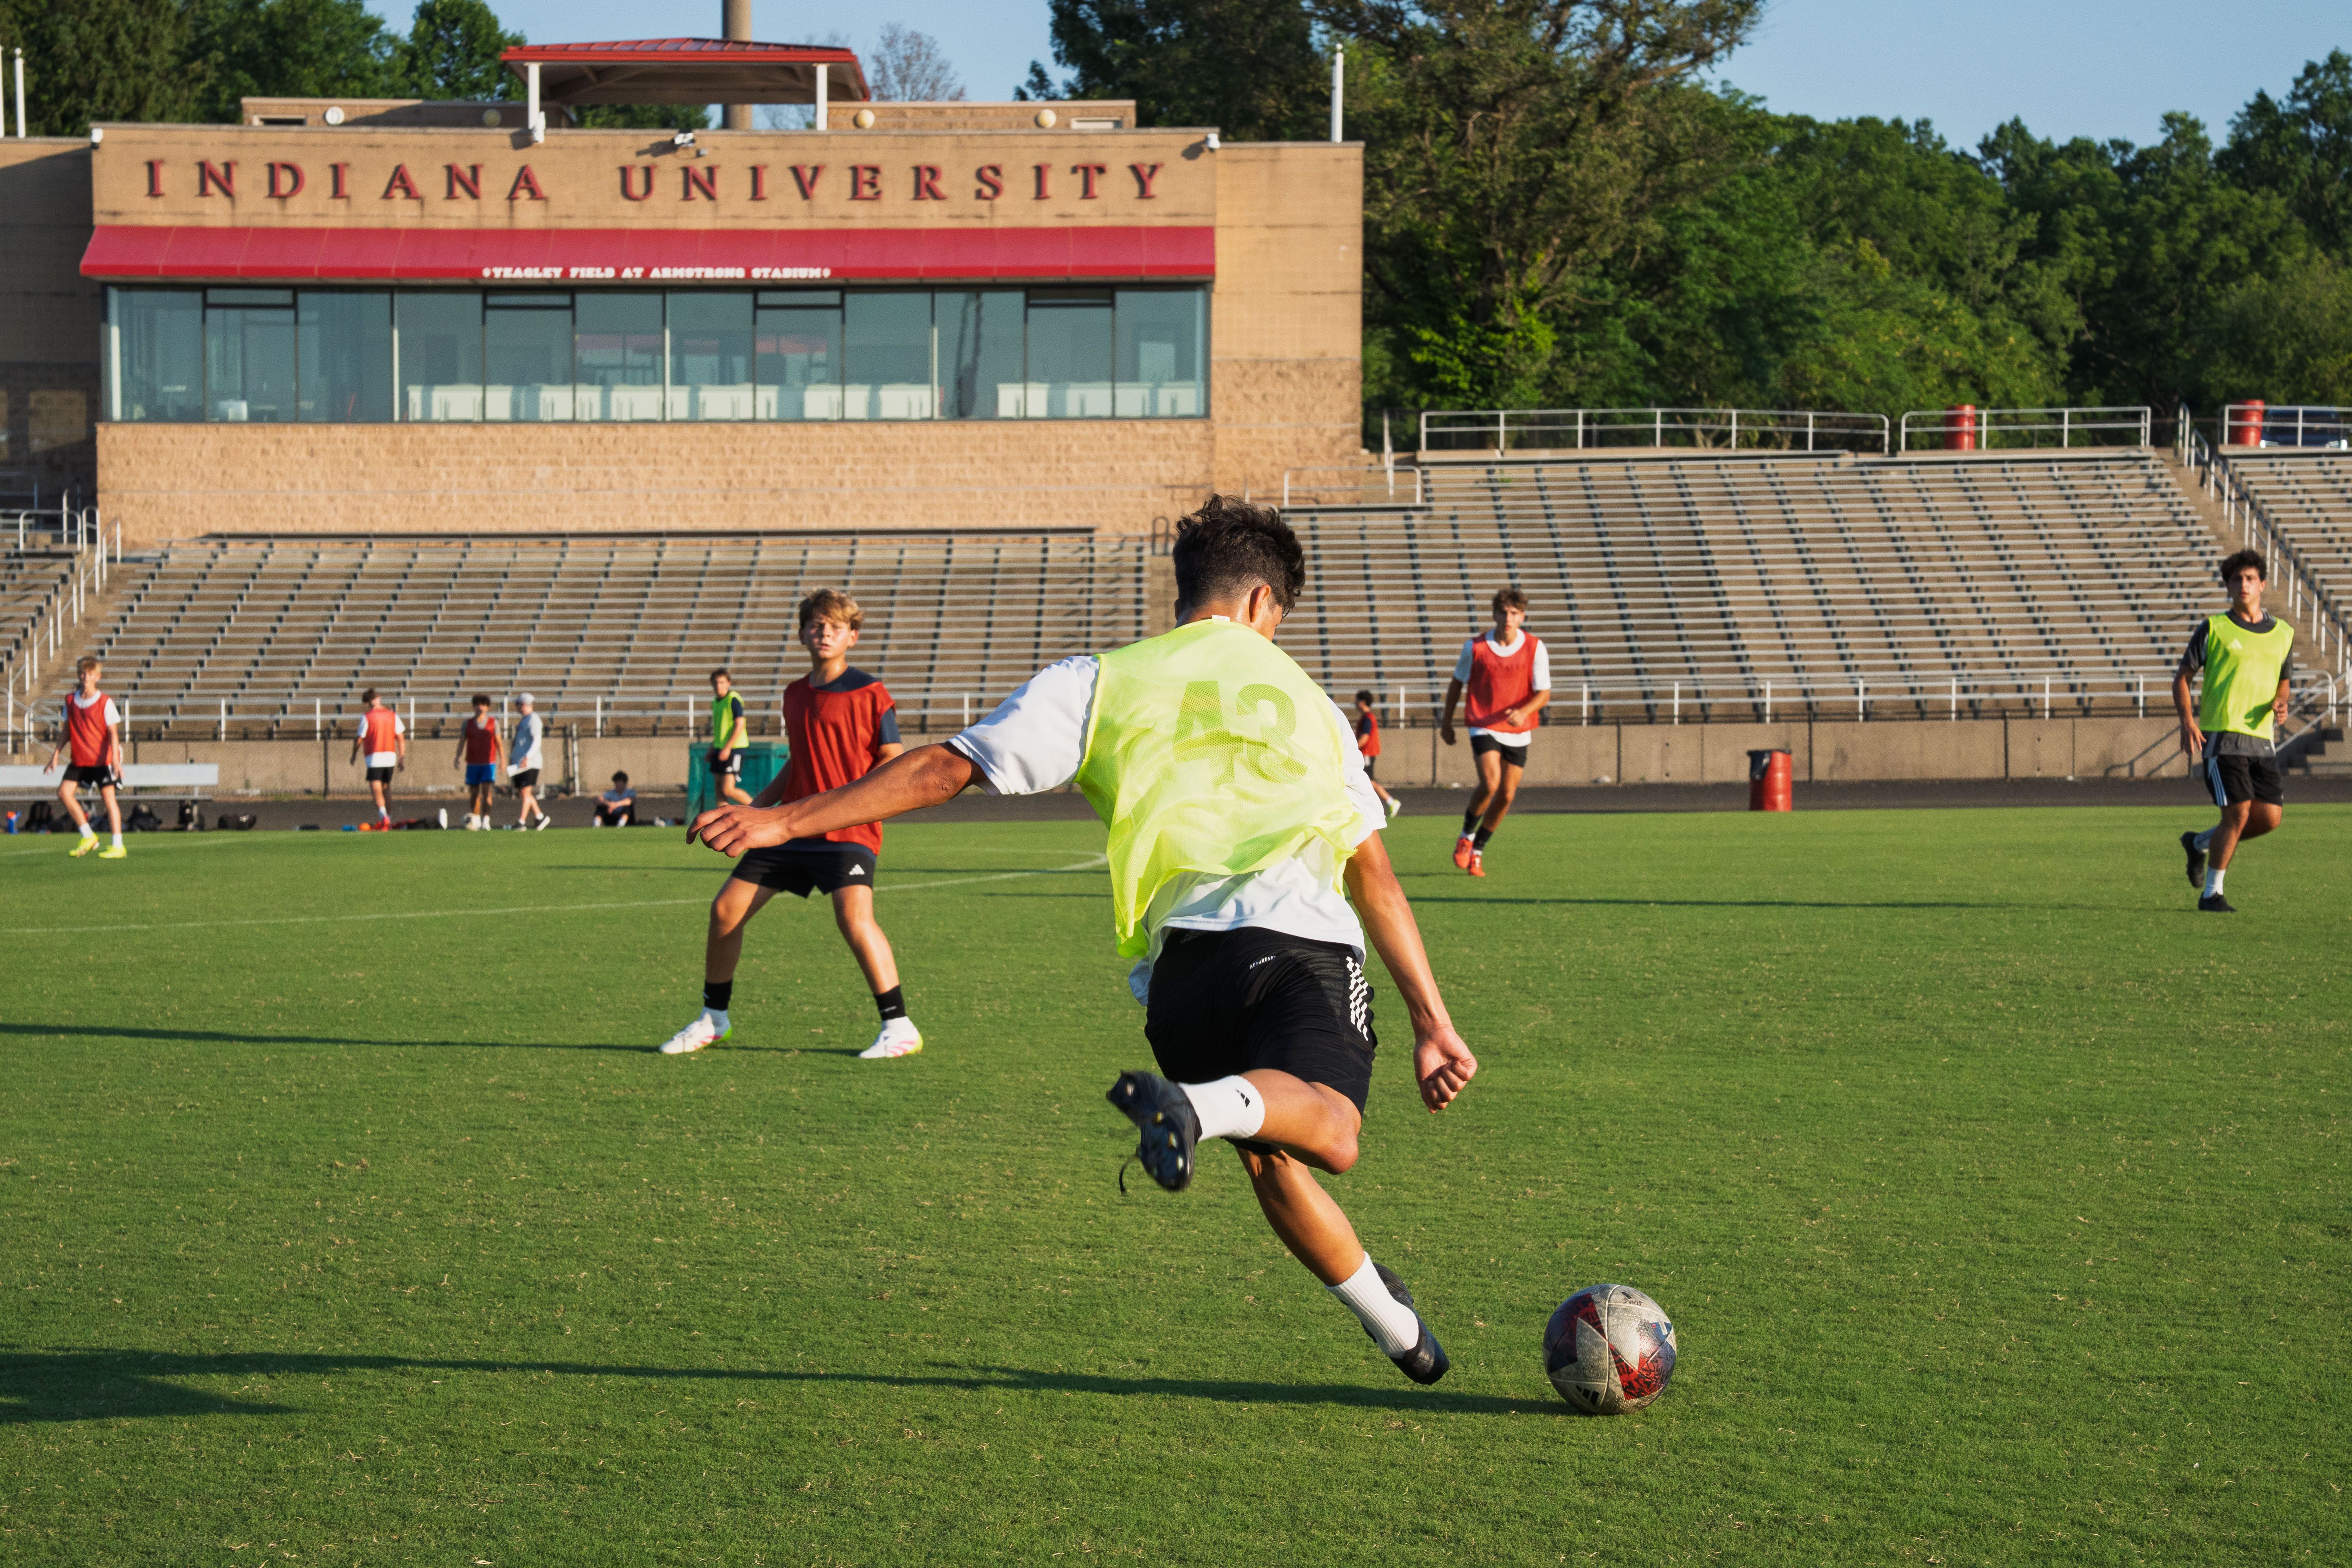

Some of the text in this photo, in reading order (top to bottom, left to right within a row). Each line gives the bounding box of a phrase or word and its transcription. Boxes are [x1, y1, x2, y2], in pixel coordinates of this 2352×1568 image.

[145, 159, 1165, 201] INDIANA UNIVERSITY
[492, 267, 821, 278] YEAGLEY FIELD AT ARMSTRONG STADIUM
